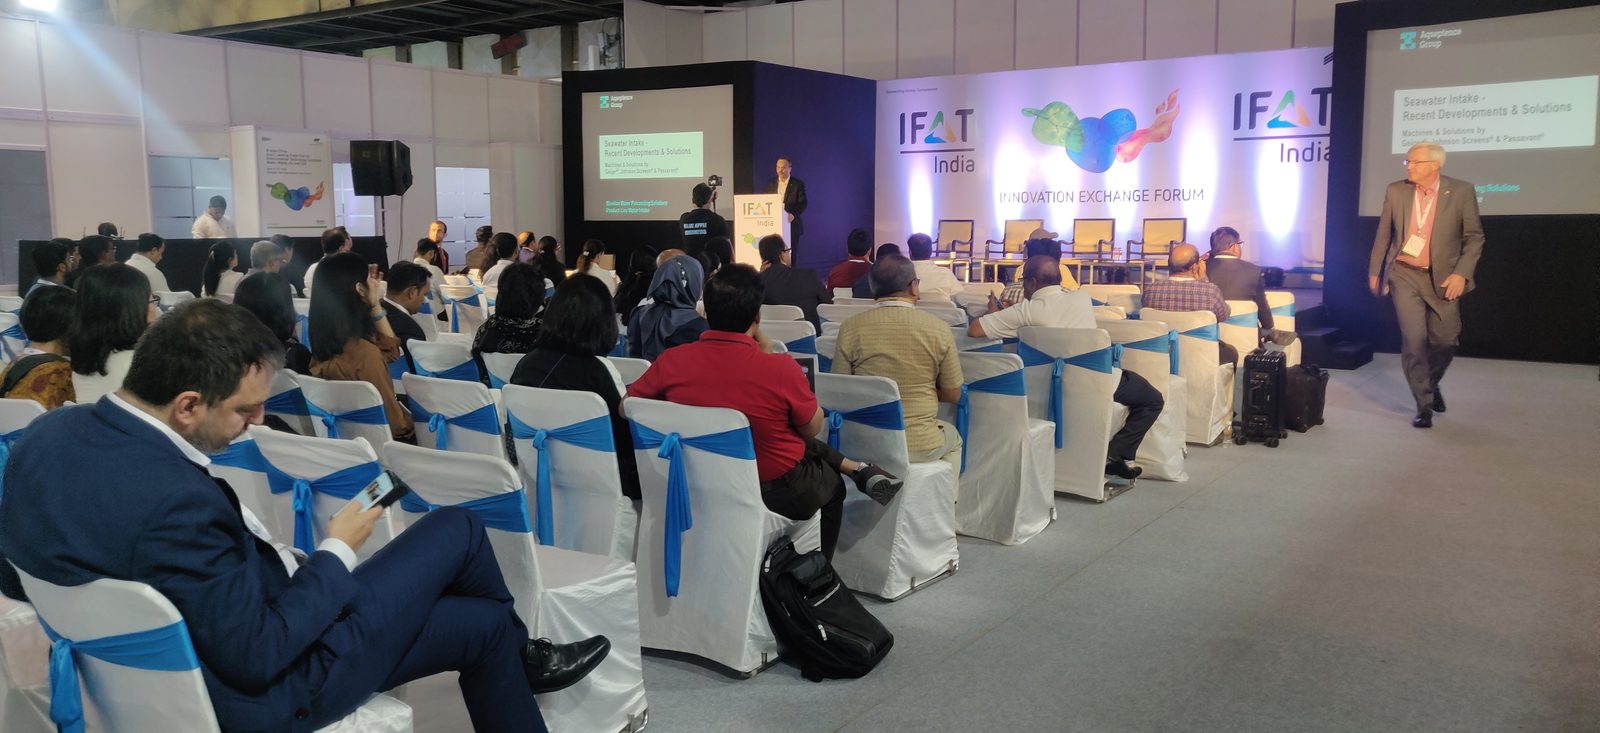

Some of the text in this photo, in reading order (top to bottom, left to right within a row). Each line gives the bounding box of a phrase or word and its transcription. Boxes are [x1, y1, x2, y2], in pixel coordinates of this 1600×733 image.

[1419, 40, 1442, 49] Group
[1403, 96, 1447, 107] Seawater
[1449, 94, 1479, 104] Intake
[1233, 86, 1333, 131] IFAT
[1403, 102, 1572, 121] Recent Developments & Solutions
[900, 109, 974, 145] IFAT
[1402, 129, 1433, 137] Machines
[1442, 127, 1475, 136] Solutions
[1476, 126, 1486, 135] by
[605, 140, 628, 148] Seawater
[628, 139, 644, 147] Intake
[623, 148, 659, 158] Developments
[666, 147, 692, 155] Solutions
[1280, 141, 1330, 163] India
[934, 155, 975, 173] India
[1000, 188, 1204, 204] INNOVATION EXCHANGE FORUM
[743, 202, 773, 216] IFAT
[757, 219, 775, 227] India
